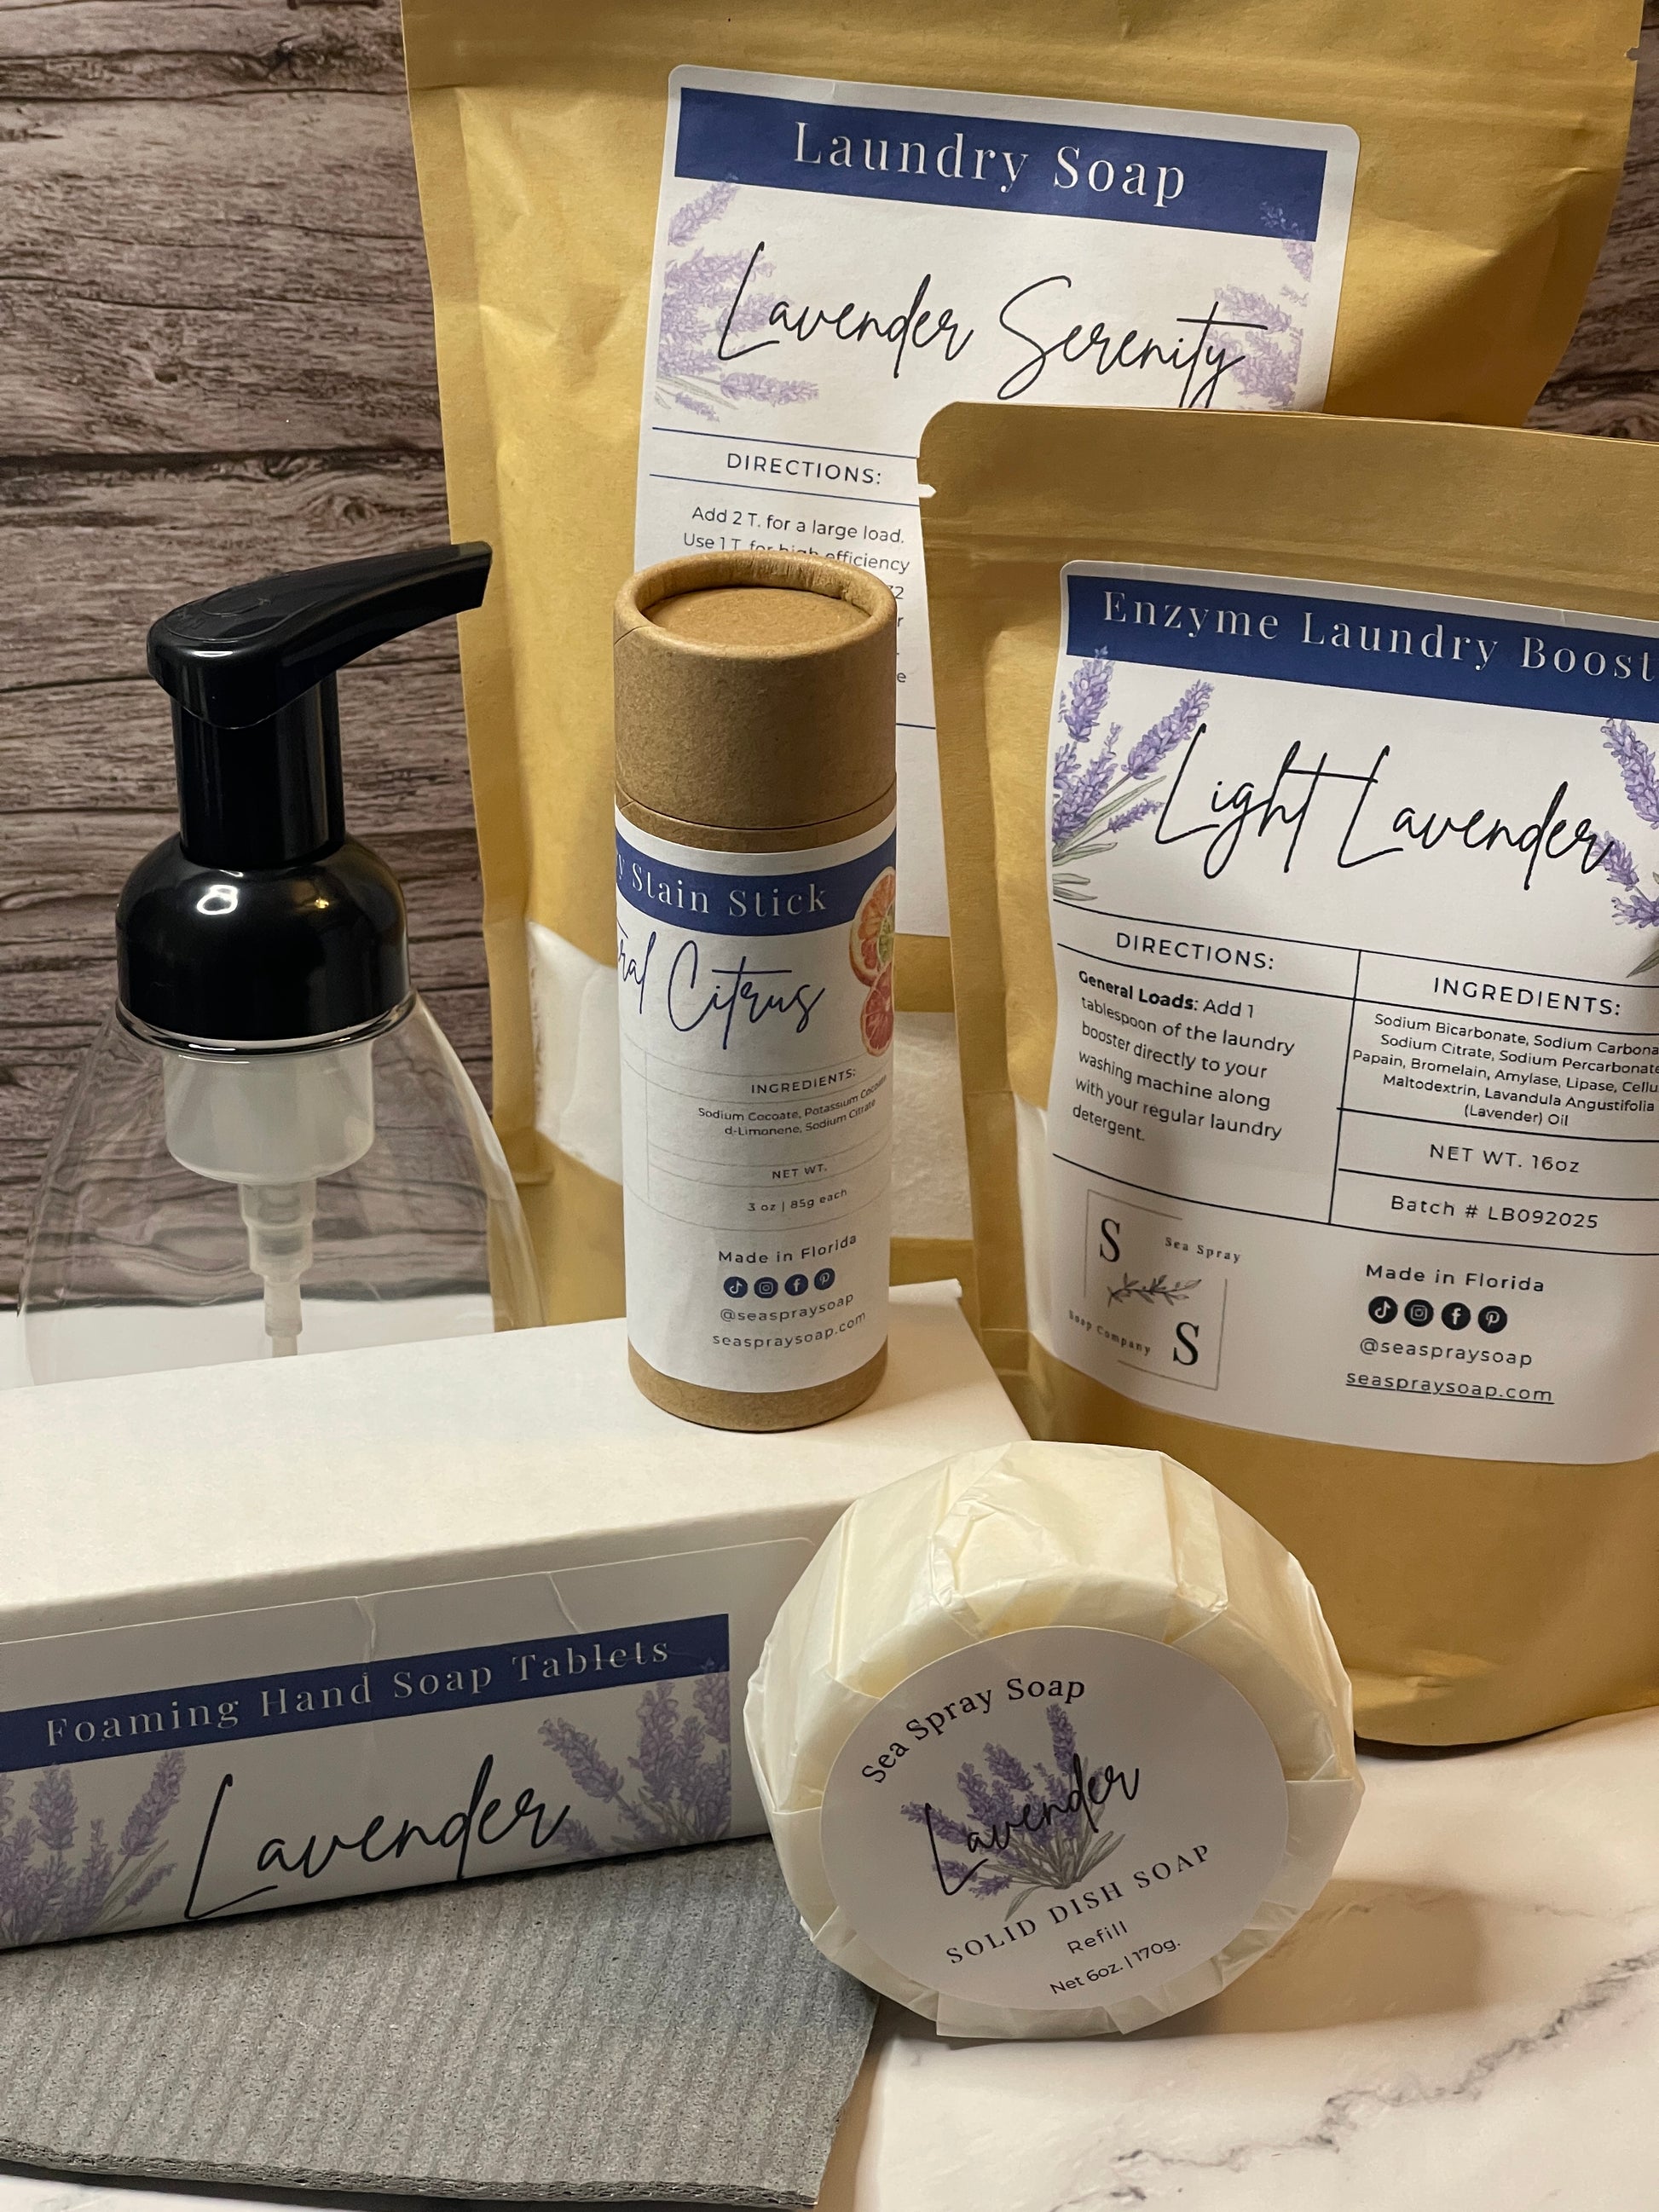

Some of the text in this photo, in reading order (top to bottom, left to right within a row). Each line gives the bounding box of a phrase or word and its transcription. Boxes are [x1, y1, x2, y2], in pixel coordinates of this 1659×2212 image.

[795, 121, 1185, 208] Laundry Soap
[718, 241, 1269, 408] Lavender Serenity
[726, 452, 882, 484] DIRECTIONS:
[684, 533, 714, 550] Use
[691, 505, 905, 543] Add 2 T. for a large load.
[1102, 590, 1656, 682] Enzyme Laundry Boost
[1155, 722, 1617, 890] Light Lavender
[632, 862, 709, 914] Stain
[729, 882, 827, 918] Stick
[1115, 932, 1275, 970] DIRECTIONS:
[617, 916, 826, 1050] ral Citrus
[1078, 970, 1254, 1019] General Loads: Add 1
[1433, 976, 1621, 1016] INGREDIENTS:
[1081, 996, 1295, 1057] tablespoon of the laundry
[1374, 1013, 1431, 1031] Sodium
[1435, 1022, 1529, 1047] Bicarbonate,
[1534, 1034, 1593, 1052] Sodium
[1082, 1020, 1269, 1079] booster directly to your
[1380, 1033, 1437, 1053] Sodium
[1442, 1042, 1494, 1062] Citrate,
[1499, 1049, 1558, 1066] Sodium
[751, 1067, 856, 1094] INGREDIENTS:
[1078, 1050, 1270, 1112] washing machine along
[1353, 1048, 1406, 1071] Papain,
[1411, 1057, 1490, 1081] Bromelain,
[1494, 1068, 1561, 1089] Amylase,
[1566, 1076, 1617, 1094] Lipase,
[698, 1107, 744, 1122] Sodium
[748, 1111, 801, 1123] Cocoate,
[805, 1095, 858, 1118] Potassium
[1076, 1077, 1282, 1141] with your regular laundry
[1383, 1073, 1655, 1112] Maltodextrin, Lavandula Angustifolia
[725, 1125, 802, 1136] d-Limonene,
[806, 1115, 847, 1131] Sodium
[1072, 1105, 1146, 1142] detergent.
[1464, 1103, 1569, 1126] (Lavender) Oil
[772, 1163, 827, 1180] NET WT.
[1430, 1143, 1580, 1174] NET WT. 16oz
[748, 1203, 755, 1211] 3
[760, 1203, 776, 1211] oz
[790, 1198, 814, 1209] 85g
[819, 1188, 847, 1204] each
[1390, 1195, 1599, 1229] Batch # LB092025
[718, 1235, 857, 1263] Made in Florida
[1099, 1217, 1121, 1263] S
[1165, 1236, 1242, 1264] Sea Spray
[1366, 1263, 1545, 1293] Made in Florida
[720, 1293, 854, 1322] @seaspraysoap
[712, 1312, 866, 1349] seaspraysoap.com
[1068, 1309, 1151, 1356] Soap Company
[1173, 1321, 1200, 1366] S
[1359, 1337, 1533, 1369] @seaspraysoap
[1345, 1372, 1555, 1405] seaspraysoap.com
[46, 1638, 669, 1747] Foaming Hand Soap Tablets
[861, 1678, 1085, 1784] Sea Spray Soap
[184, 1753, 571, 1920] Lavender
[924, 1753, 1140, 1896] Lavender
[946, 1845, 1209, 1965] SOLID DISH SOAP
[1067, 1920, 1128, 1955] Refill
[1049, 1976, 1085, 1995] Net
[1086, 1962, 1124, 1982] 6oz.
[1132, 1938, 1182, 1962] 170g.
